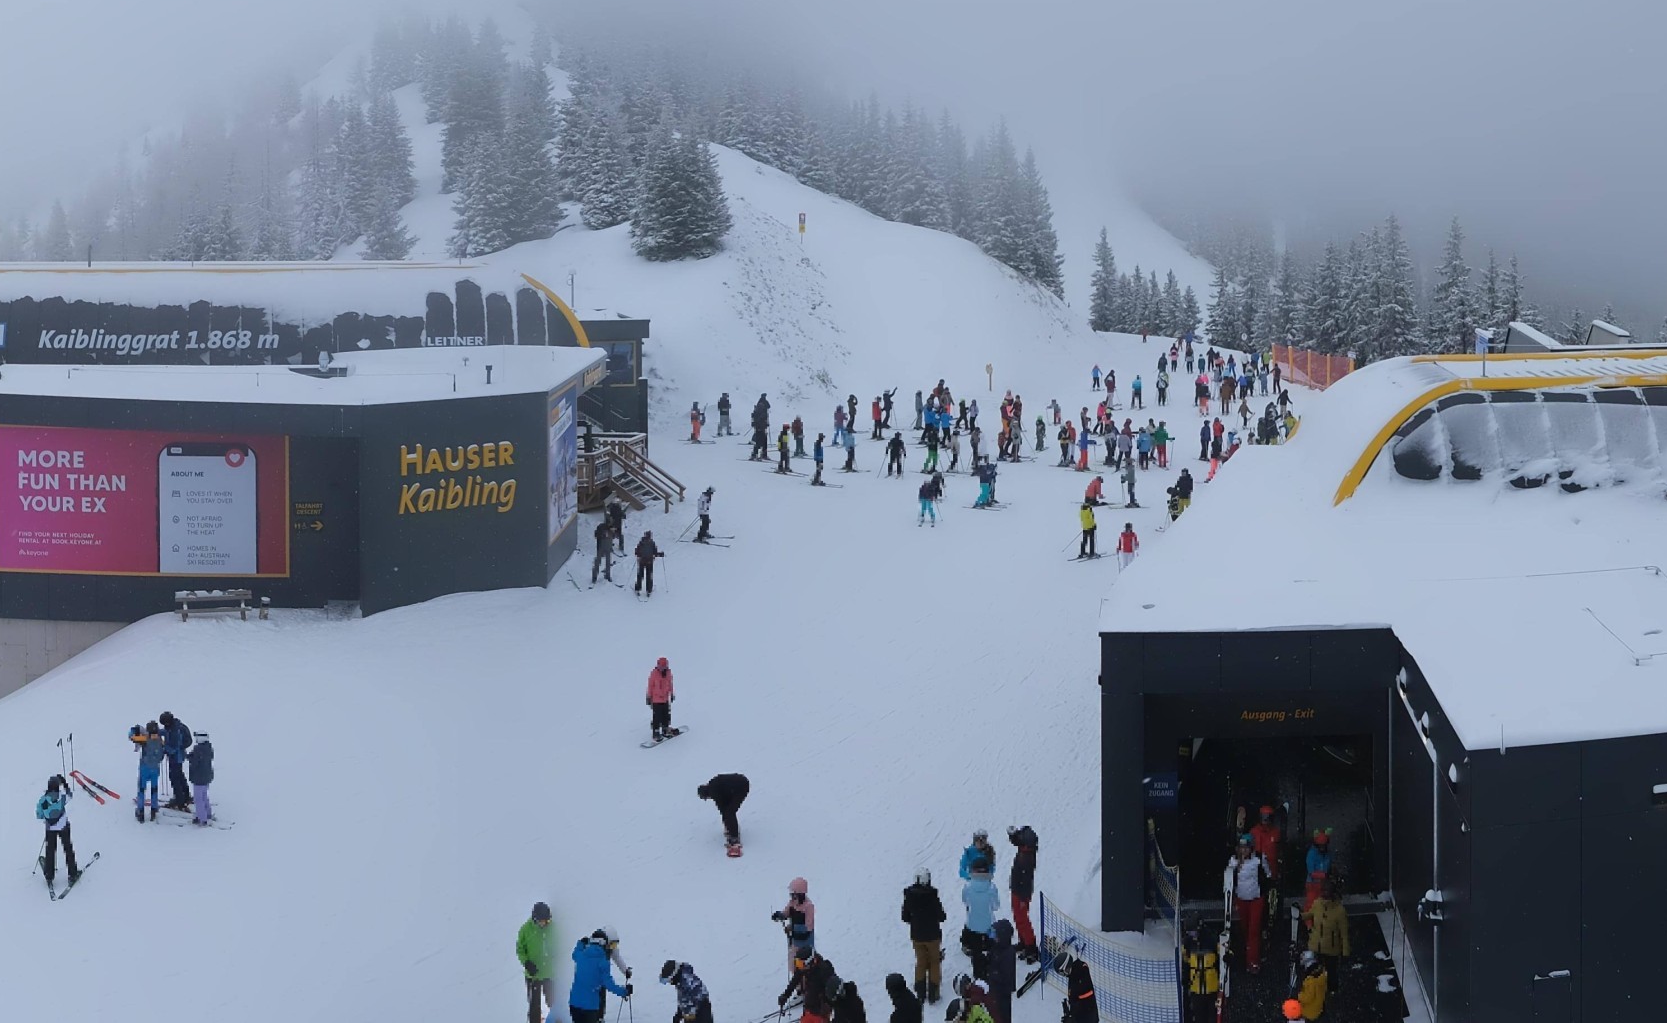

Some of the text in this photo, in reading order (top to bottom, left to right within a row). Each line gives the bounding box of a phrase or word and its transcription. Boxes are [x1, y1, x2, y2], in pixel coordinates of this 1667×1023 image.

[38, 329, 280, 355] Kaiblinggrat 1.868 m
[427, 336, 484, 346] LEITNER
[18, 450, 85, 468] MORE
[400, 441, 514, 476] HAUSER
[18, 472, 126, 491] FUN THAN
[398, 475, 517, 515] Kaibling
[19, 496, 106, 513] YOUR EX
[1241, 710, 1286, 722] Ausgang
[1295, 708, 1315, 719] Exit
[1149, 789, 1174, 797] ZUGANG
